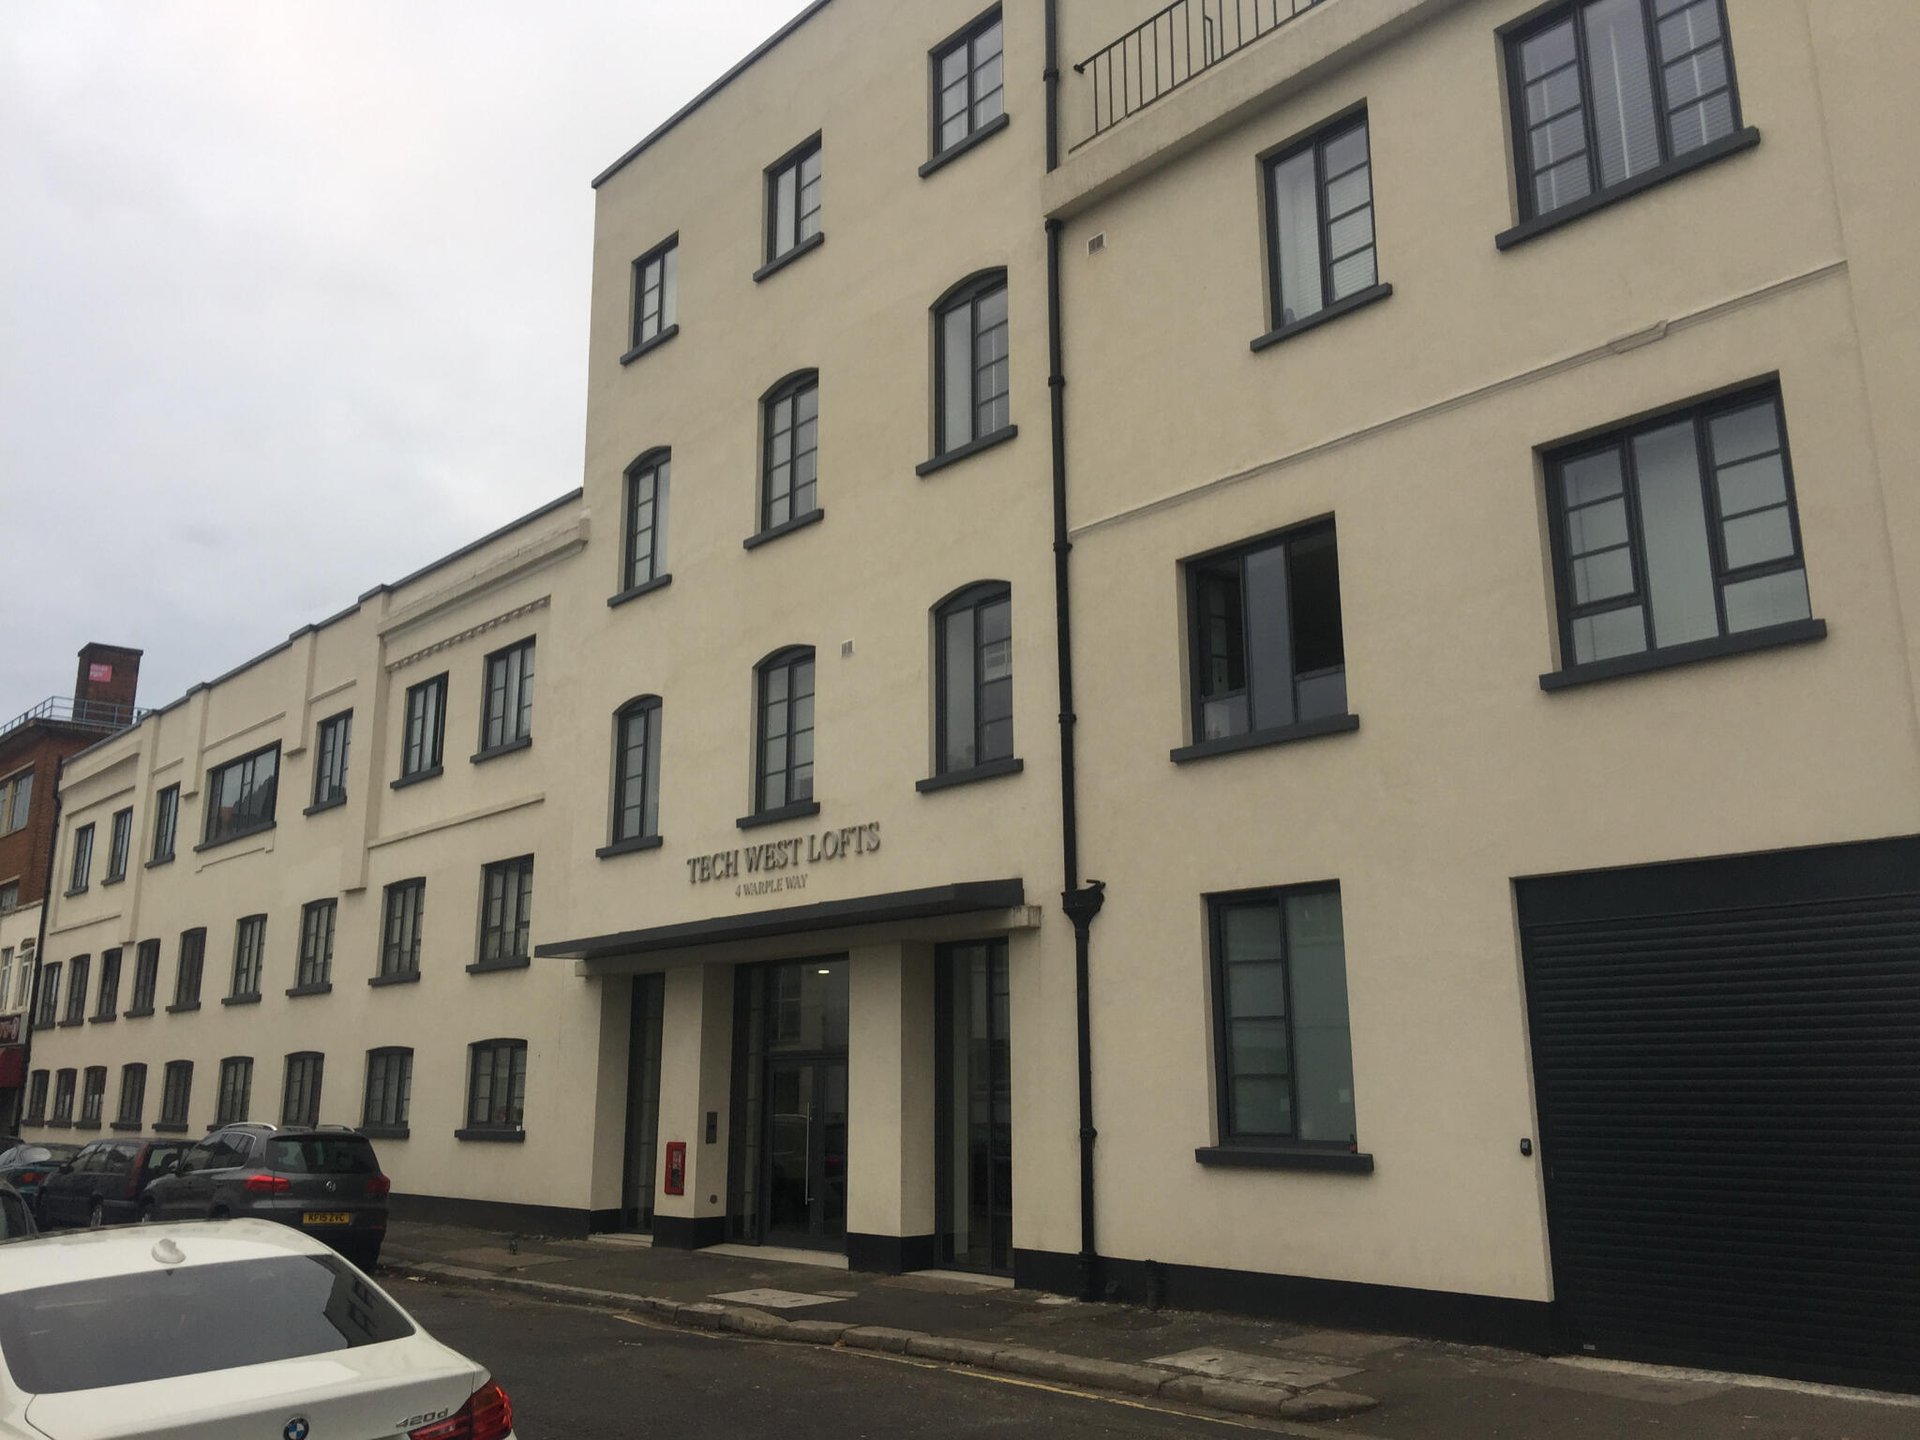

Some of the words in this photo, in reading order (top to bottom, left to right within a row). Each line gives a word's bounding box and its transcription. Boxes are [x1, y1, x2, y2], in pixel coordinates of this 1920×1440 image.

[686, 849, 740, 884] TECH
[743, 837, 803, 873] WEST
[806, 821, 881, 863] LOFTS
[735, 884, 741, 897] 4
[743, 877, 784, 896] WARPLE
[785, 873, 808, 890] WAY
[396, 1408, 449, 1428] 420d
